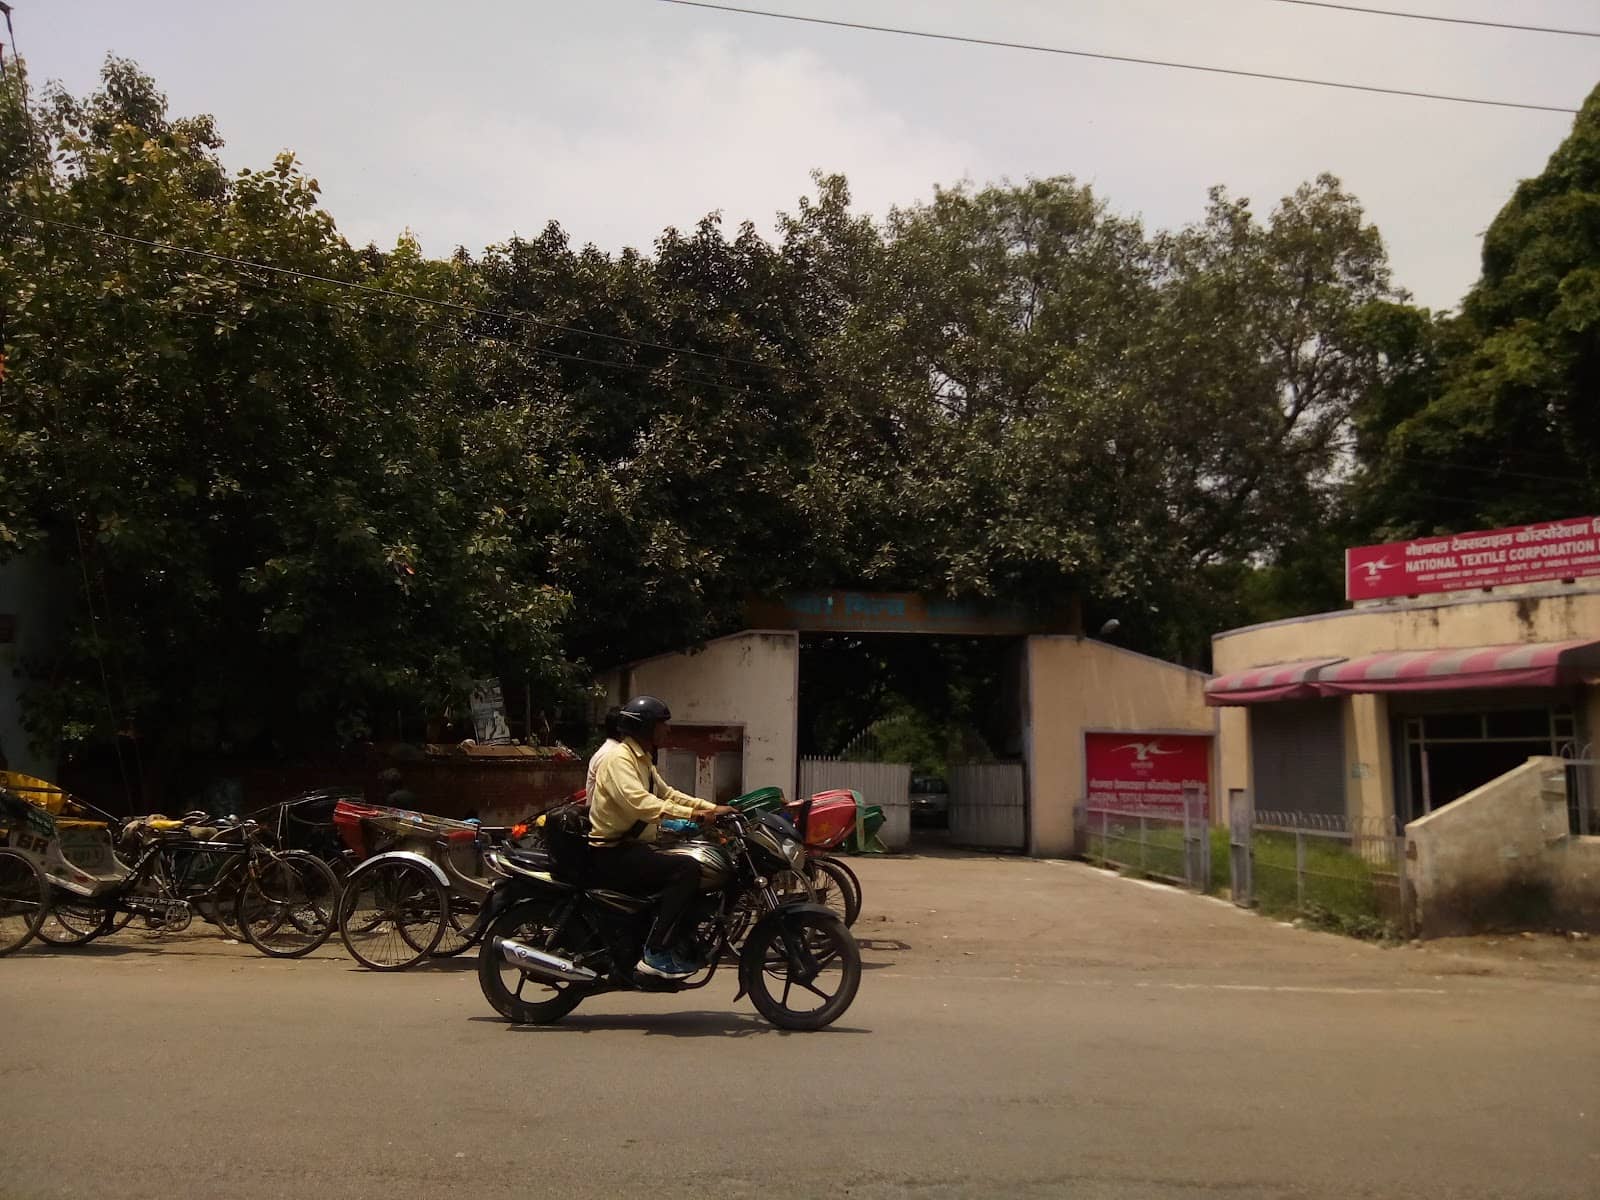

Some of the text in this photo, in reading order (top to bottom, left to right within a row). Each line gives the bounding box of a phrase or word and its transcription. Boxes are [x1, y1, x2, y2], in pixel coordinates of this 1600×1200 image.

[1405, 539, 1595, 573] NATIONAL TEXTILE CORPORATION
